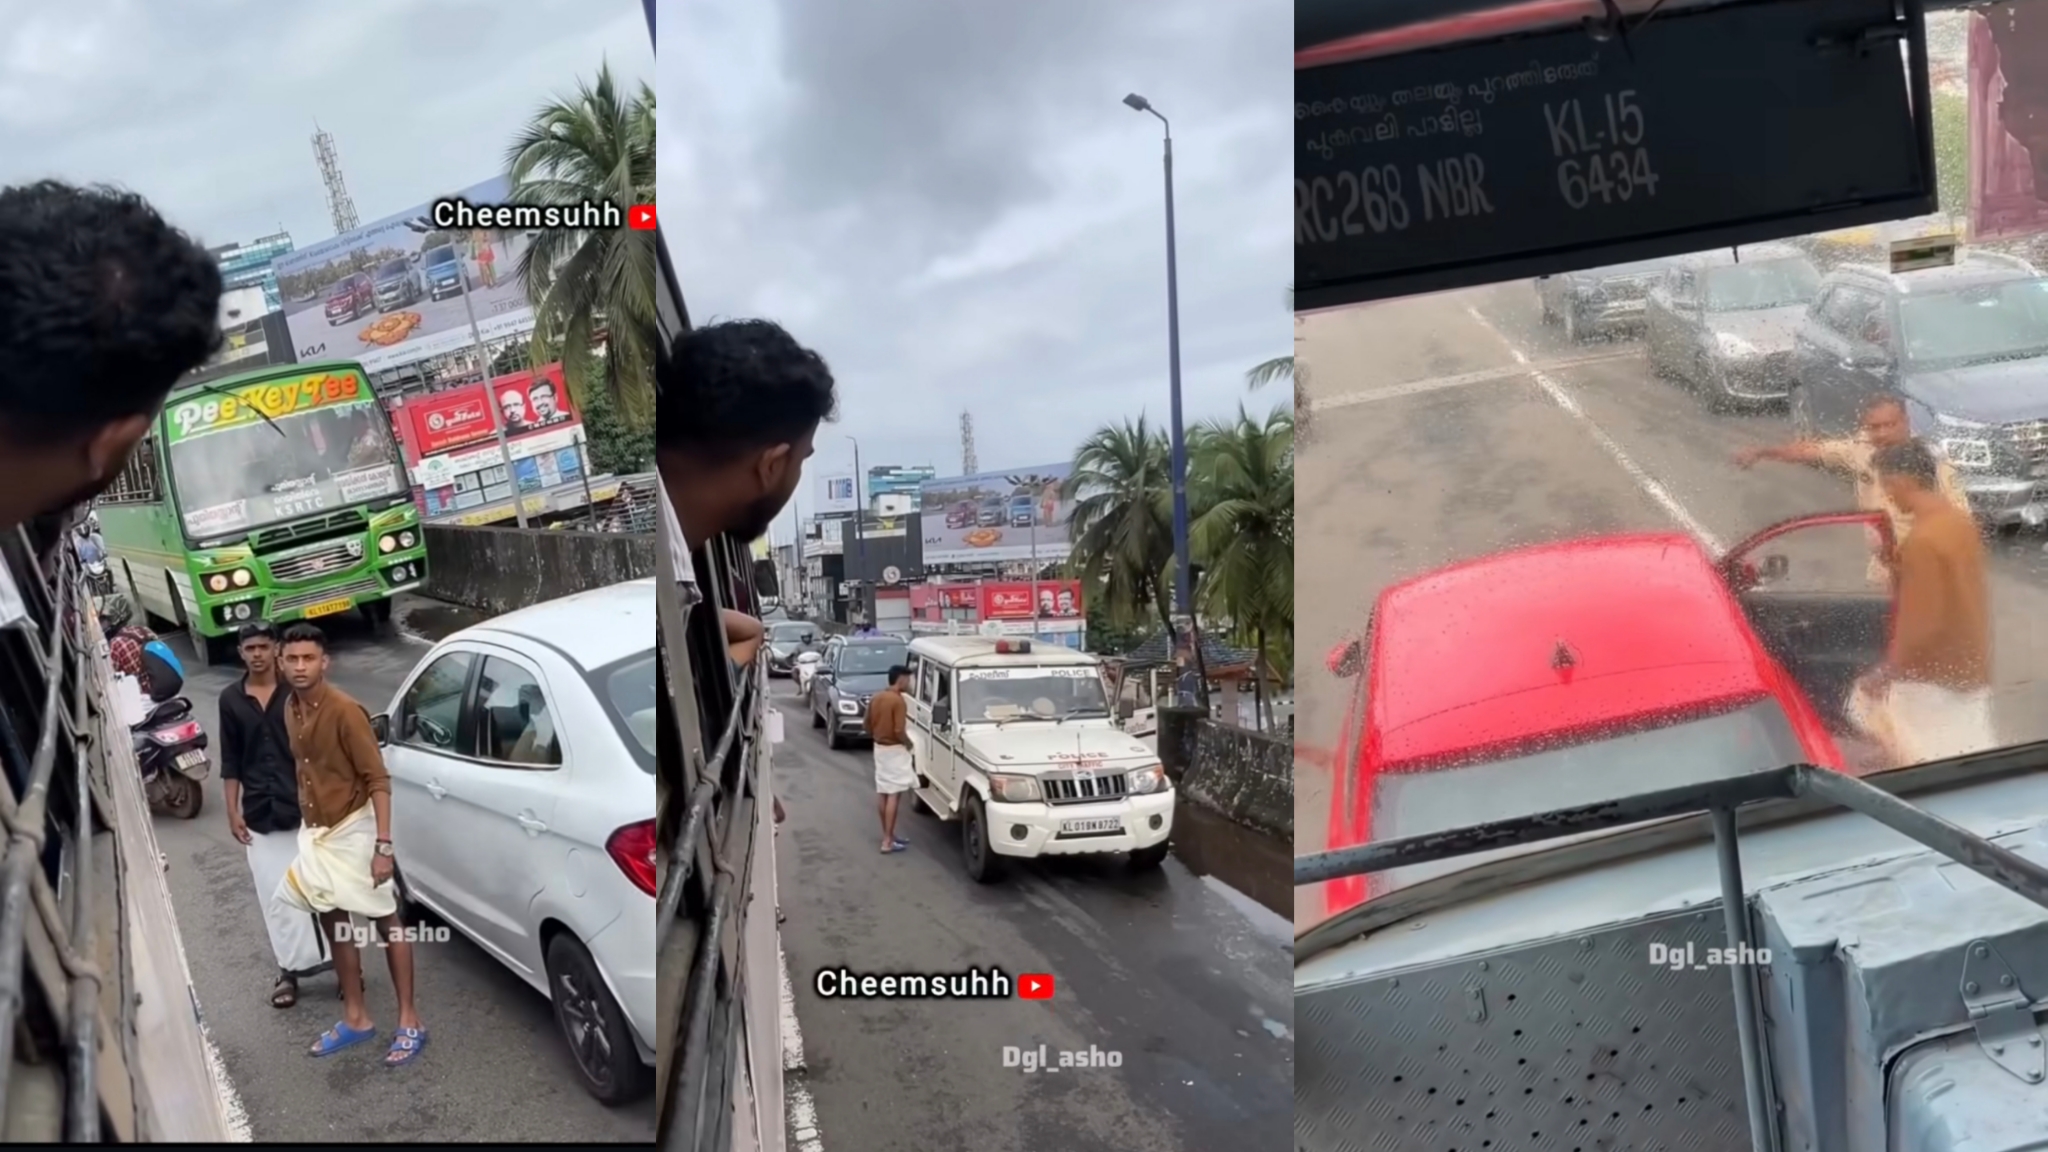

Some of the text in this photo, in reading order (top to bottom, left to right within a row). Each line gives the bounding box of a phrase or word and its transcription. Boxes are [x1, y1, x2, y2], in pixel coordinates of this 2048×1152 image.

[1543, 89, 1646, 157] KL-15
[1294, 152, 1495, 246] RC268 NBR
[1557, 147, 1660, 209] 6434
[173, 395, 238, 436] Pee
[301, 372, 359, 406] Tee
[273, 496, 325, 517] KSRTC
[1051, 669, 1091, 678] POLICE
[1047, 751, 1109, 761] POLICE
